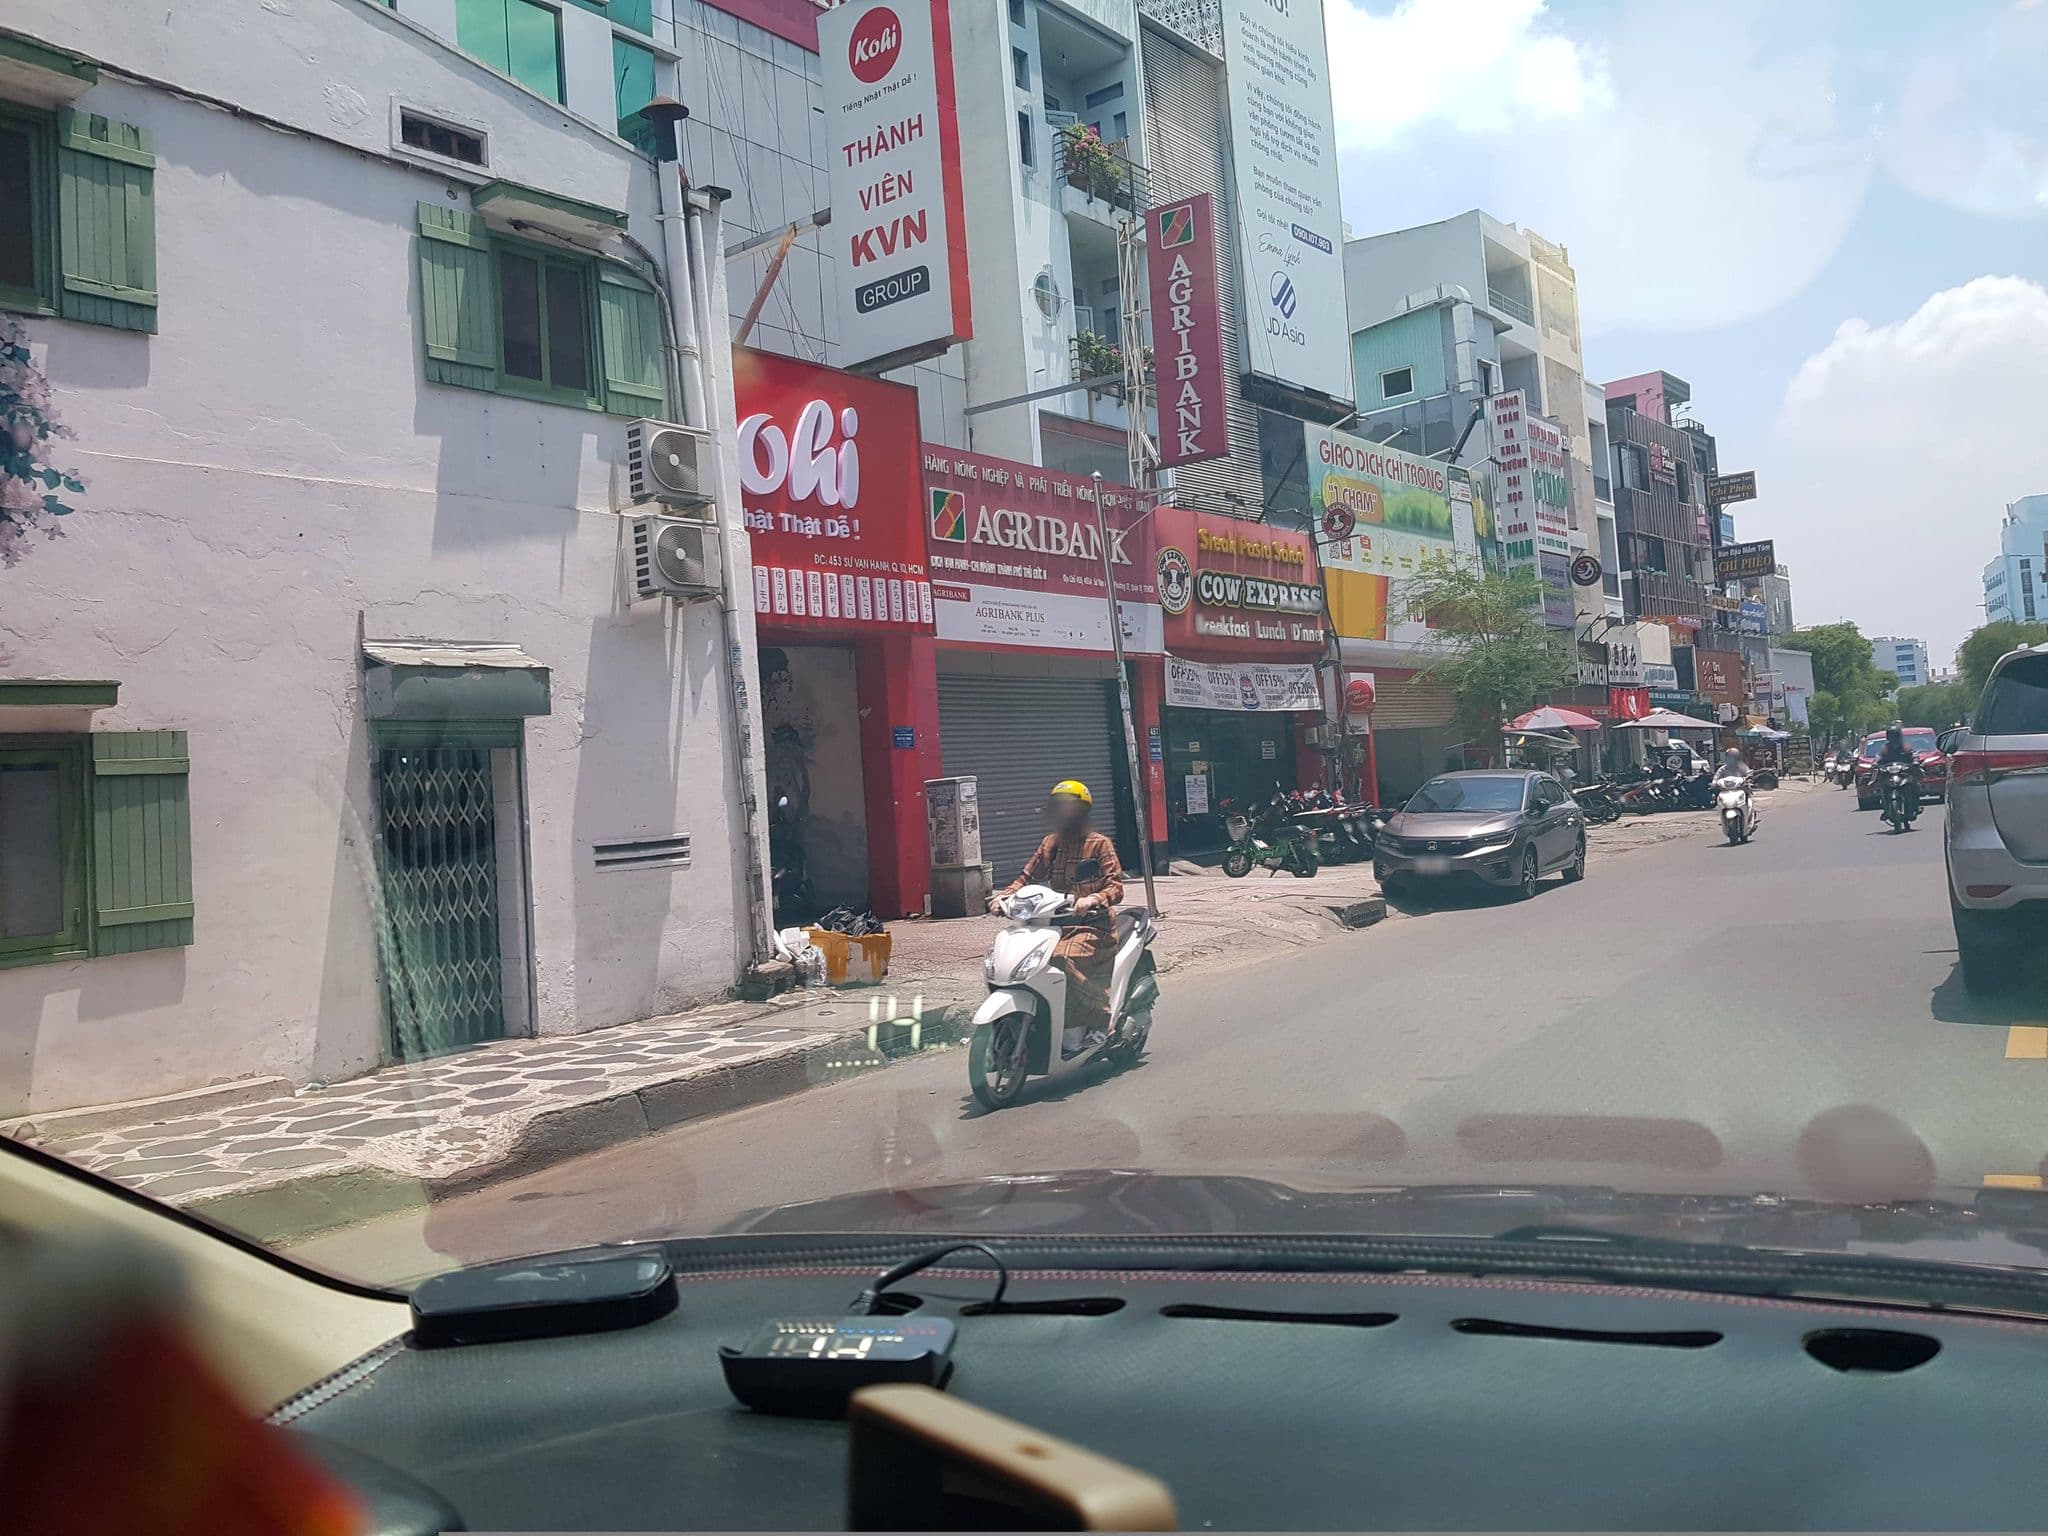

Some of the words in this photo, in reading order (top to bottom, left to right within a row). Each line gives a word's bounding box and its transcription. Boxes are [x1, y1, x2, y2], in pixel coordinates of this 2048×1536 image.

[854, 23, 897, 66] Kohi
[842, 100, 862, 114] Tiếng
[864, 90, 882, 104] Nhật
[882, 81, 900, 95] Thật
[842, 113, 924, 167] THÀNH
[858, 170, 913, 211] VIÊN
[851, 208, 928, 267] KVN
[863, 272, 922, 307] GROUP
[1266, 316, 1280, 336] JD
[1282, 322, 1305, 346] Asia
[1168, 254, 1204, 457] AGRIBANK
[737, 400, 860, 510] ohi
[1501, 443, 1520, 456] KHOA
[924, 454, 949, 474] HÀNG
[954, 460, 977, 479] NÔNG
[982, 468, 1009, 487] NGHIỆP
[1015, 472, 1024, 488] VÀ
[1030, 476, 1047, 493] PHÁT
[1319, 440, 1354, 469] GIAO
[1356, 449, 1384, 478] DỊCH
[1386, 454, 1403, 482] CHỈ
[1404, 462, 1444, 492] TRONG
[744, 508, 774, 534] hật
[778, 512, 822, 539] Thật
[824, 514, 850, 538] Dễ
[1507, 522, 1528, 535] KHOA
[1514, 508, 1518, 518] Y
[972, 505, 1132, 565] AGRIBANK
[828, 555, 841, 566] 453
[908, 564, 924, 575] HCM
[932, 589, 968, 600] AGRIBANK
[1200, 574, 1241, 601] COW
[976, 607, 1023, 621] AGRIBANK
[1026, 612, 1045, 623] PLUS
[1197, 613, 1250, 637] reakfast
[1256, 620, 1286, 640] Lunch
[1292, 623, 1324, 642] Dinner
[1578, 662, 1608, 686] CHICKEN
